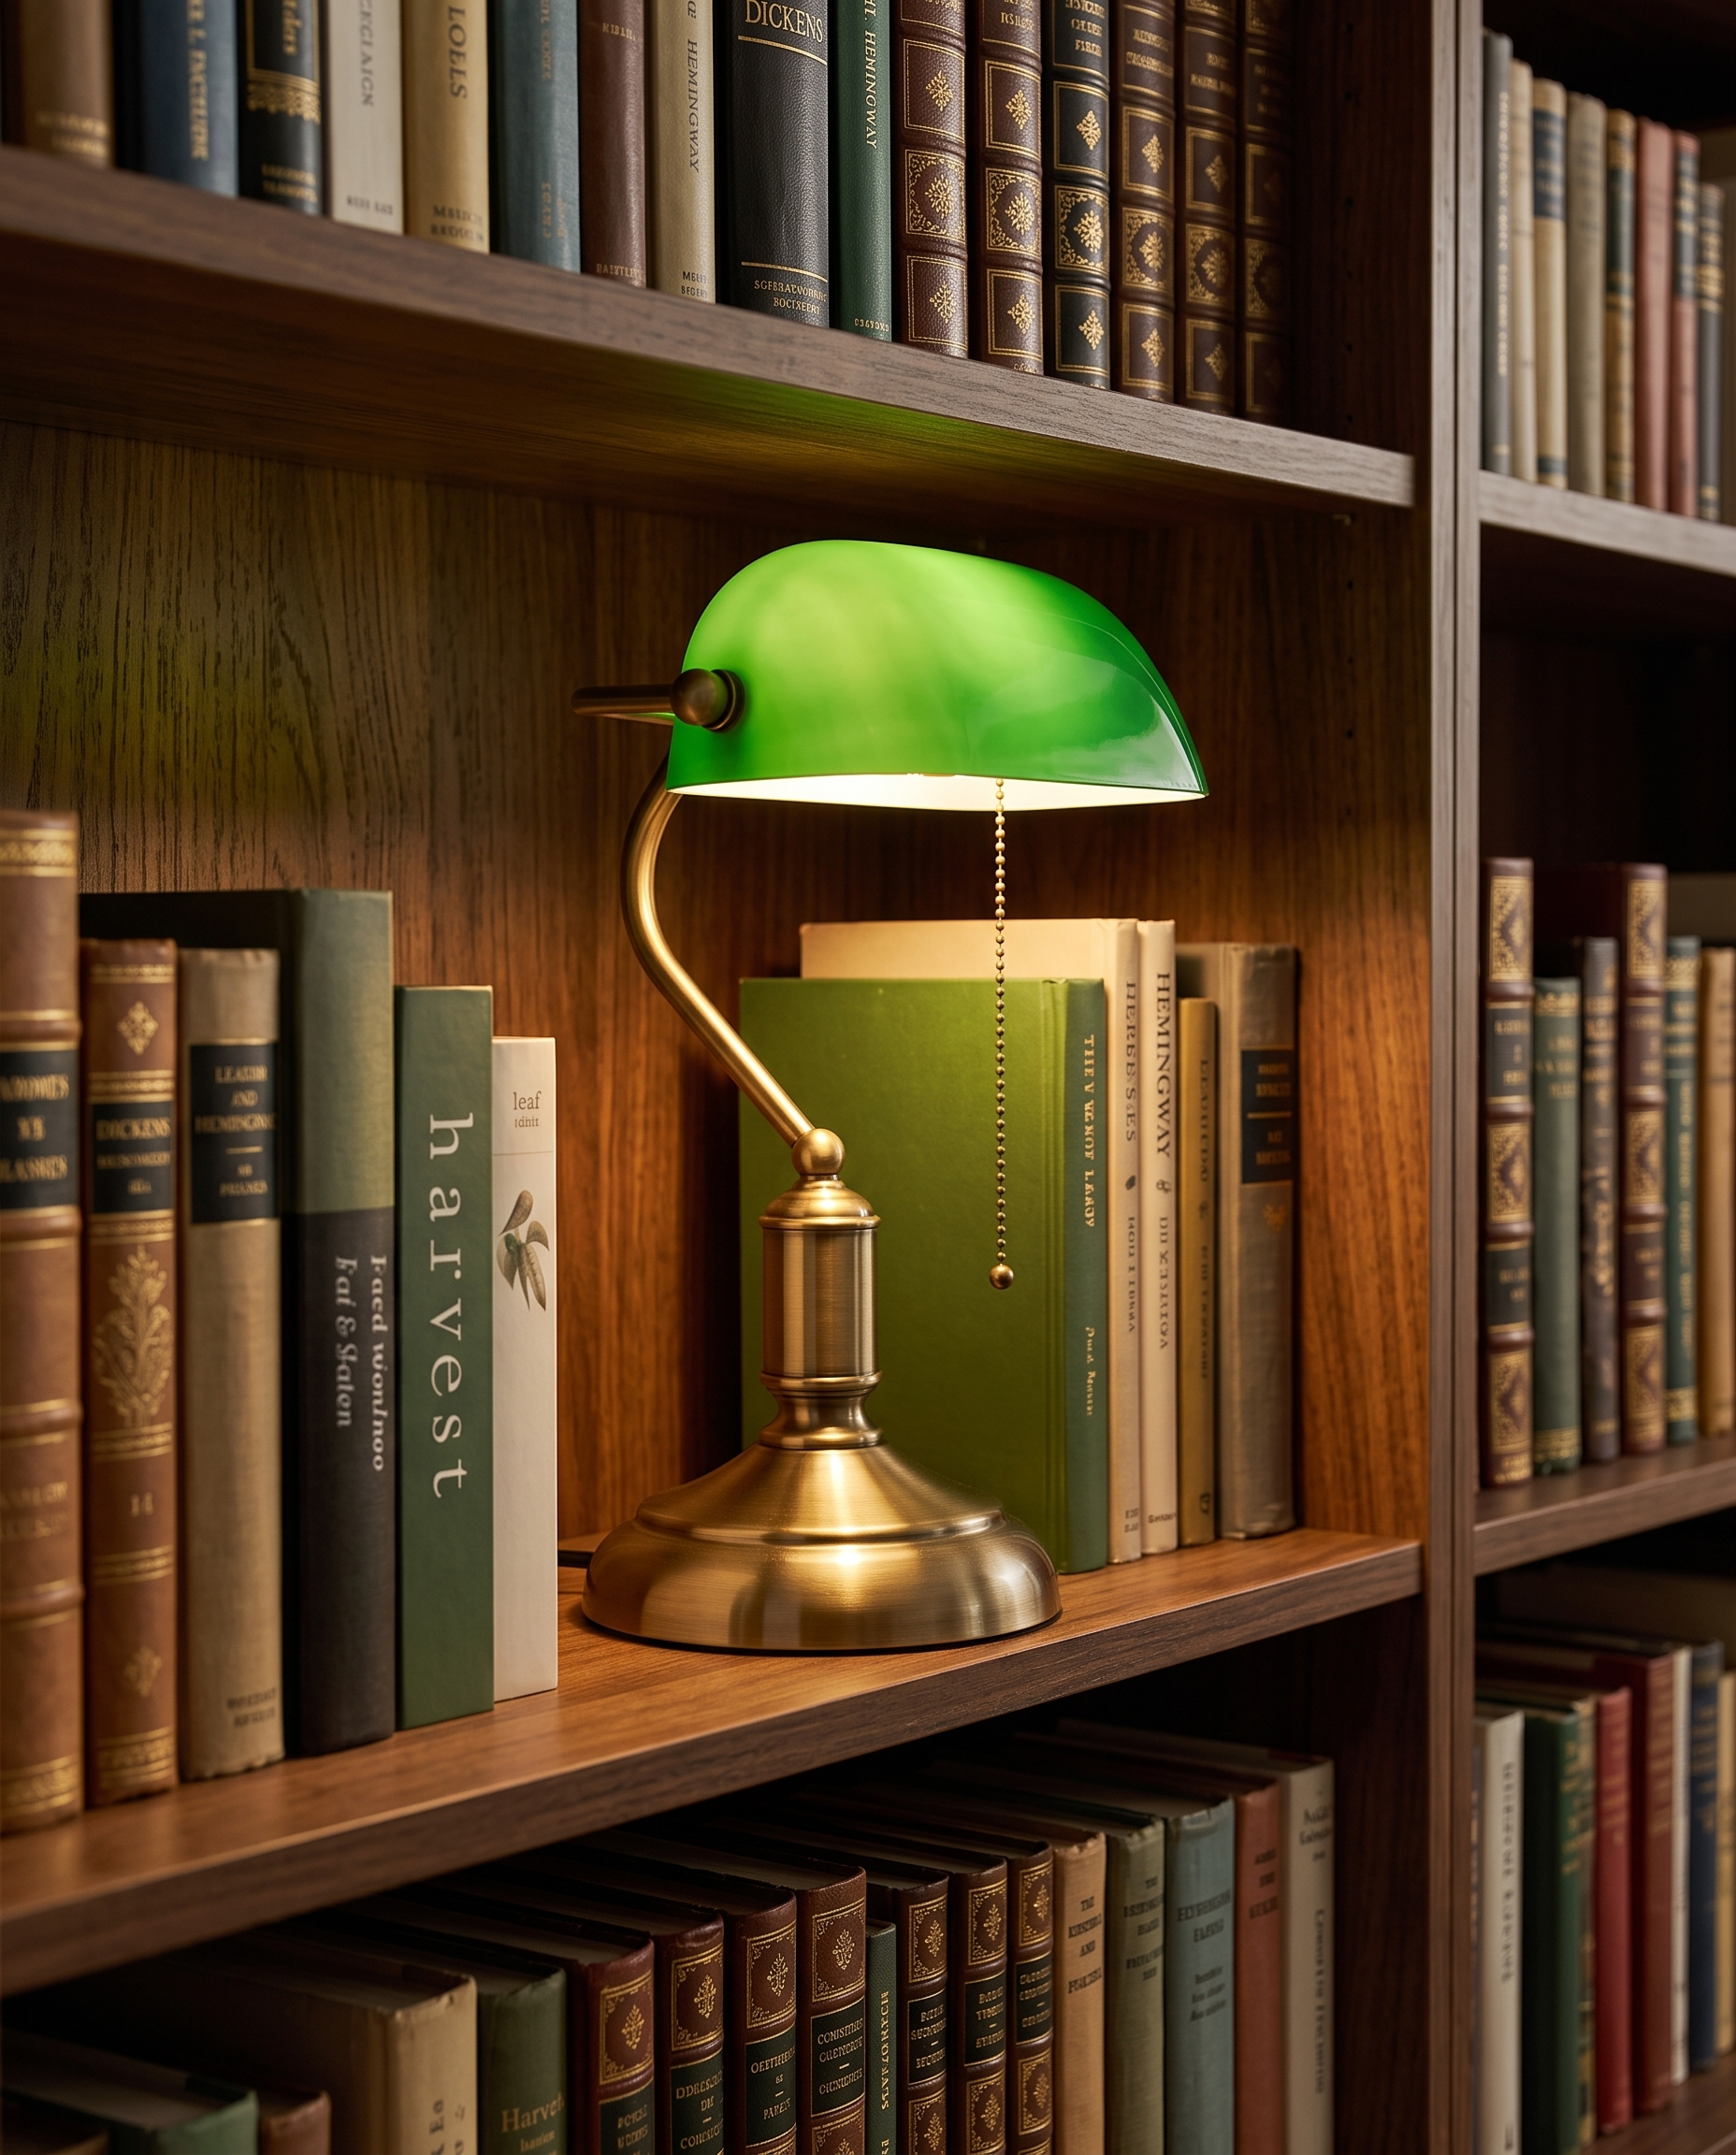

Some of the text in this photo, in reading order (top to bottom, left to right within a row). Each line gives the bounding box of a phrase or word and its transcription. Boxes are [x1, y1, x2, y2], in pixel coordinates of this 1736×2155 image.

[745, 0, 823, 43] DICKENS
[687, 38, 700, 173] HEMINGWAY
[514, 1092, 542, 1110] leaf
[1157, 973, 1170, 1157] HEMINGWAY
[429, 1112, 474, 1498] harvest
